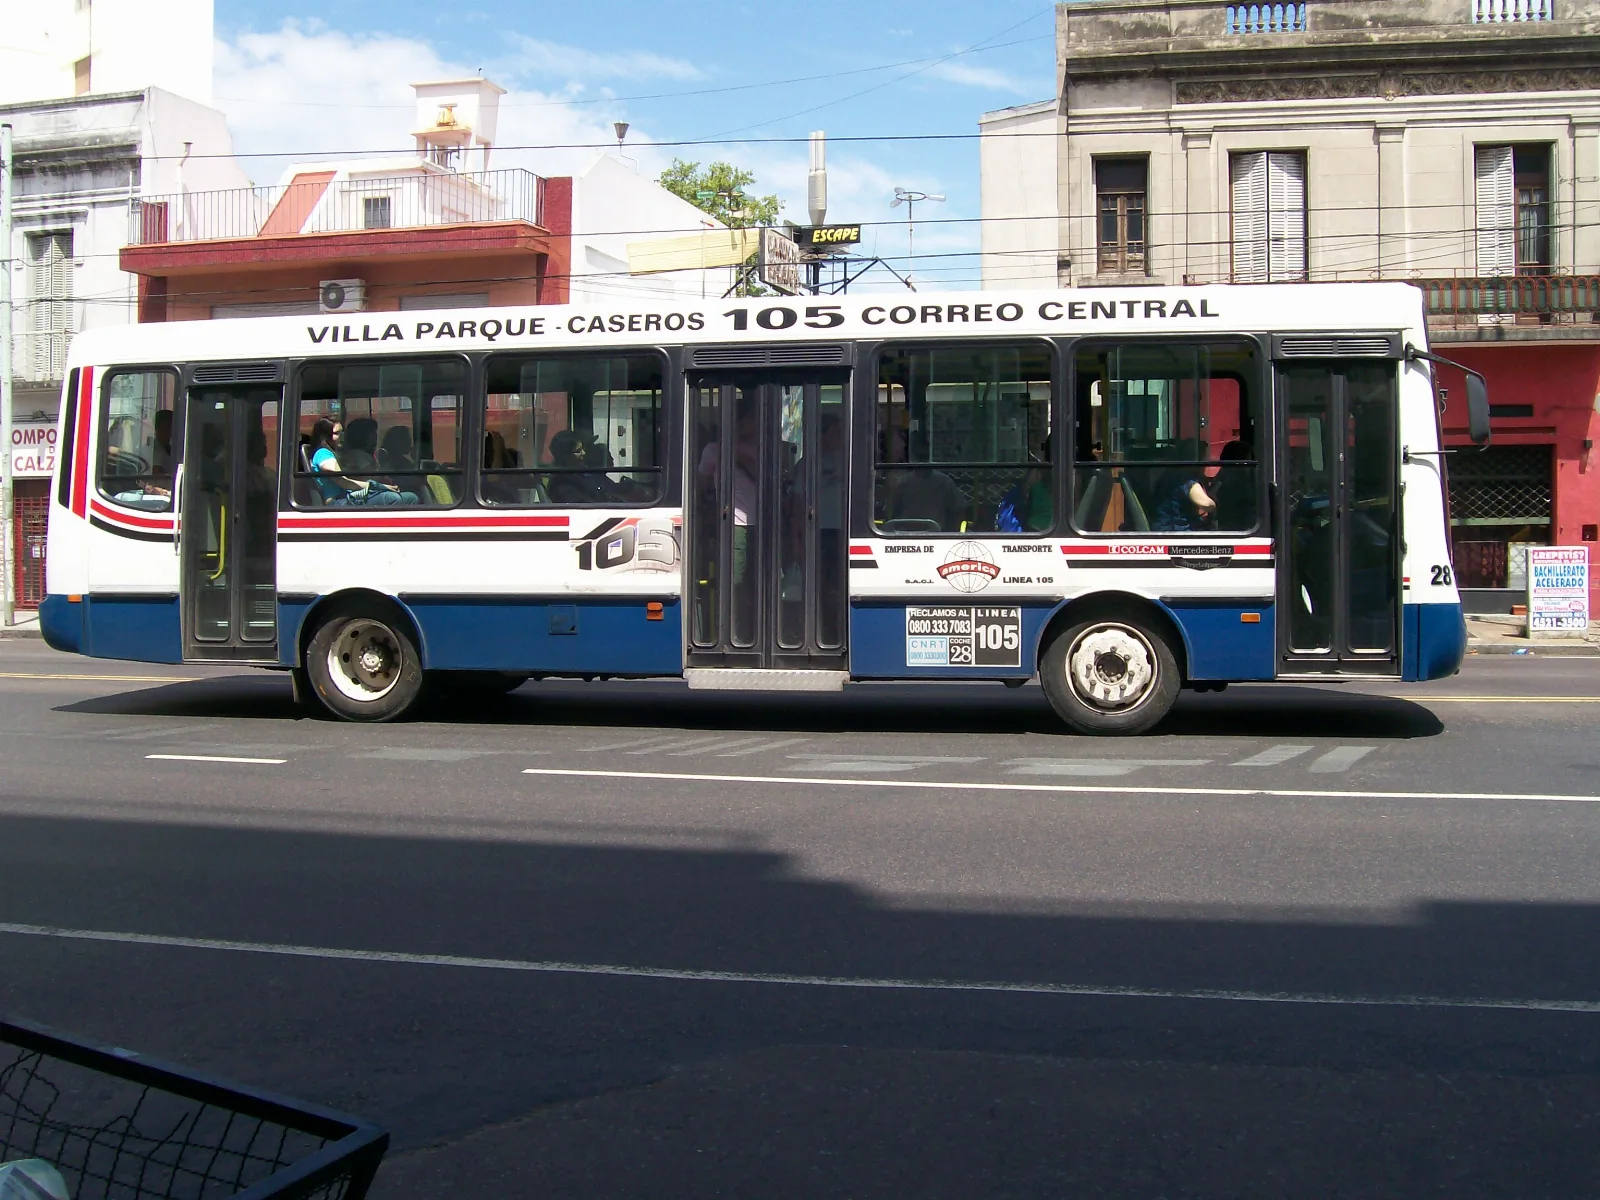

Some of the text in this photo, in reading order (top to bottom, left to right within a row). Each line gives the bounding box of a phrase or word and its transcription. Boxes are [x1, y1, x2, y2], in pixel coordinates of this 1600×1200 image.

[812, 227, 859, 243] ESCAPE
[307, 323, 403, 344] VILLA
[415, 317, 546, 342] PARQUE
[567, 313, 705, 334] CASEROS
[722, 304, 845, 331] 105
[861, 302, 1024, 325] CORREO
[1038, 299, 1220, 321] CENTRAL
[575, 519, 676, 571] 105
[884, 545, 935, 554] EMPRESA DE
[1002, 545, 1053, 553] TRANSPORTE
[1171, 546, 1232, 555] Mercedes-Benz
[940, 563, 997, 577] america
[1430, 565, 1452, 586] 28
[1534, 565, 1586, 577] BACHILLERATO
[1002, 576, 1054, 584] LINEA 105
[1535, 578, 1584, 588] ACELERADO
[910, 609, 969, 617] RECLAMOS AL
[977, 609, 1018, 618] LINEA
[909, 620, 971, 634] 0800 333 7083
[1533, 617, 1586, 628] 4521-3500
[975, 624, 1019, 650] 105
[950, 645, 972, 663] 28
